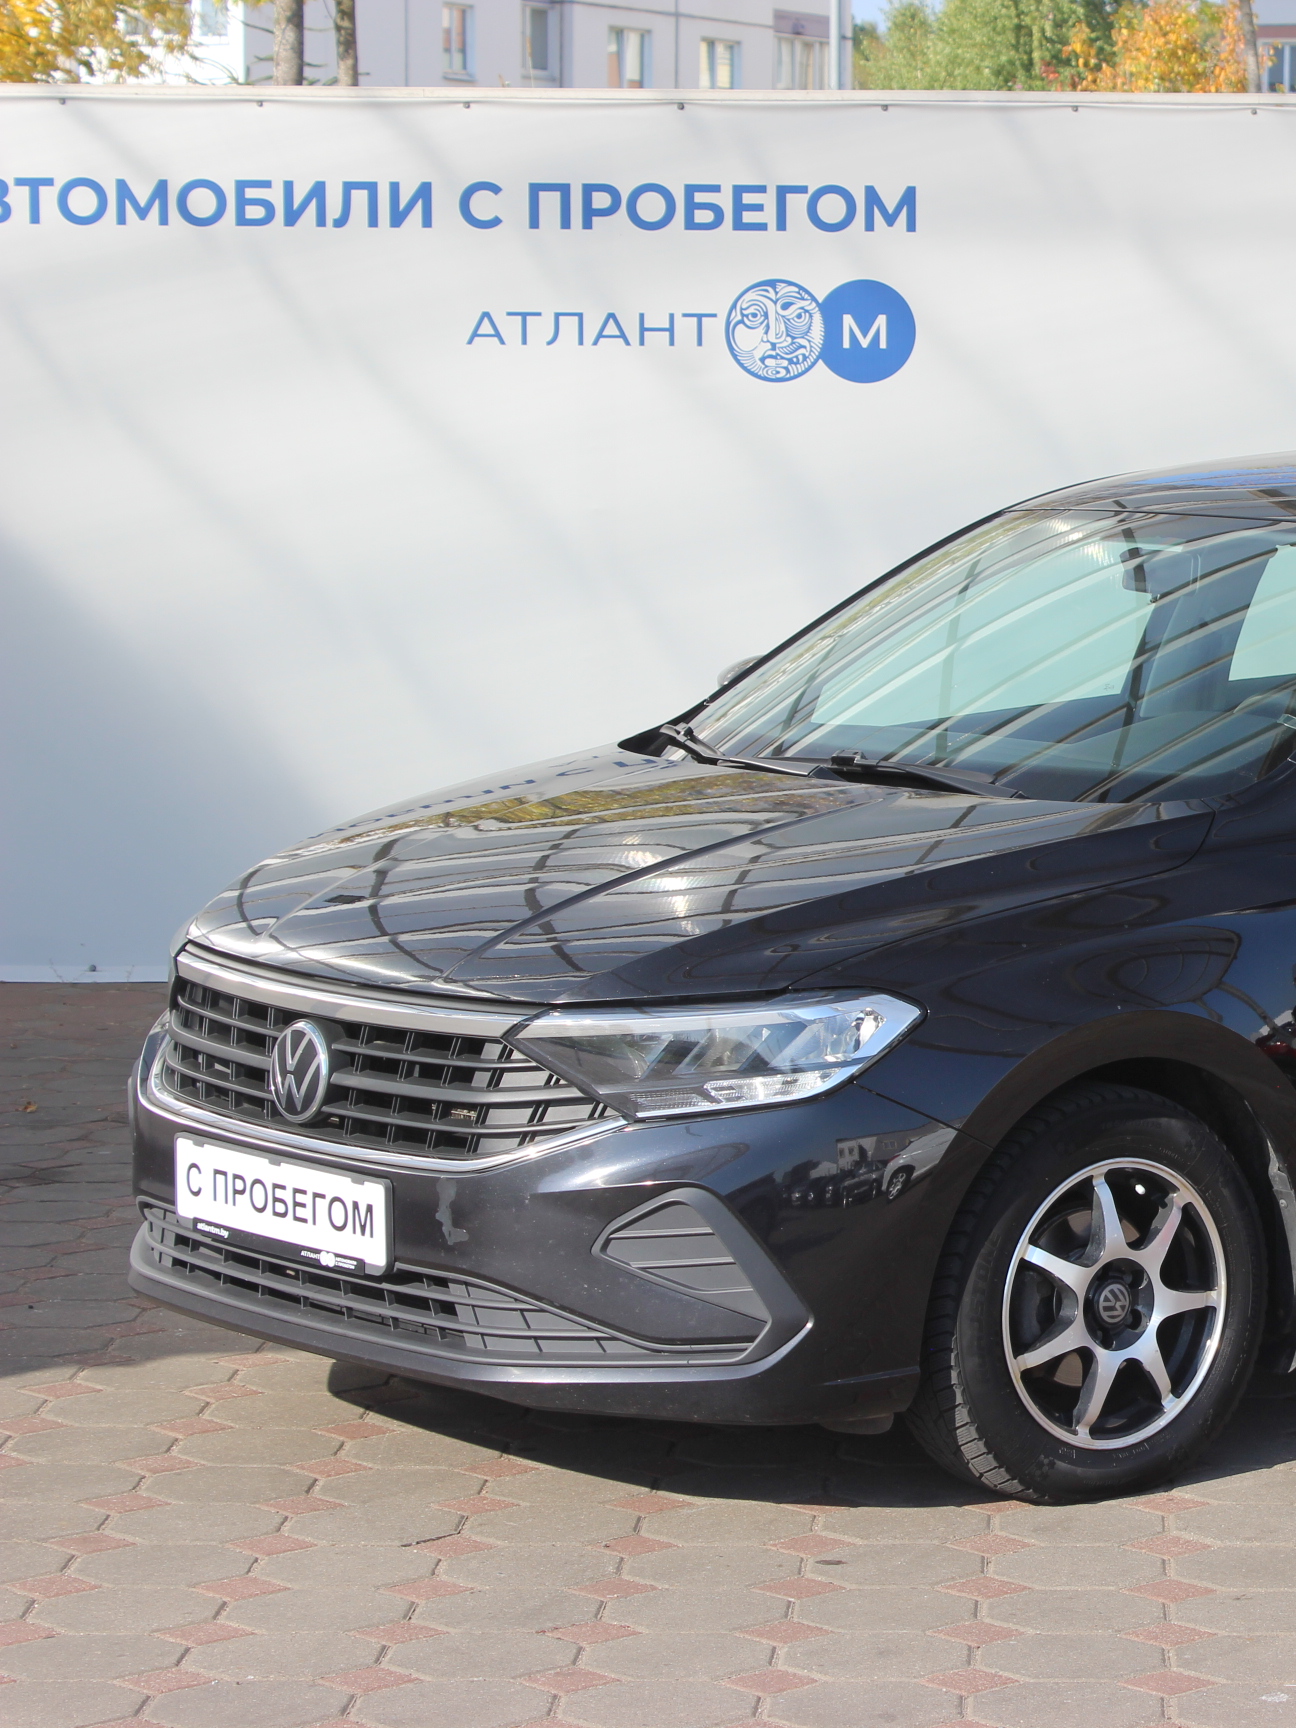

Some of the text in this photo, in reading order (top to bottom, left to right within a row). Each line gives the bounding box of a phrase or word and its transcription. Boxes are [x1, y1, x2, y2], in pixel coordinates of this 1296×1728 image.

[0, 177, 917, 232] ТОМОБИЛИ С ПРОБЕГОМ
[467, 311, 718, 347] АТЛАНТ
[186, 1162, 374, 1239] С ПРОБЕГОМ
